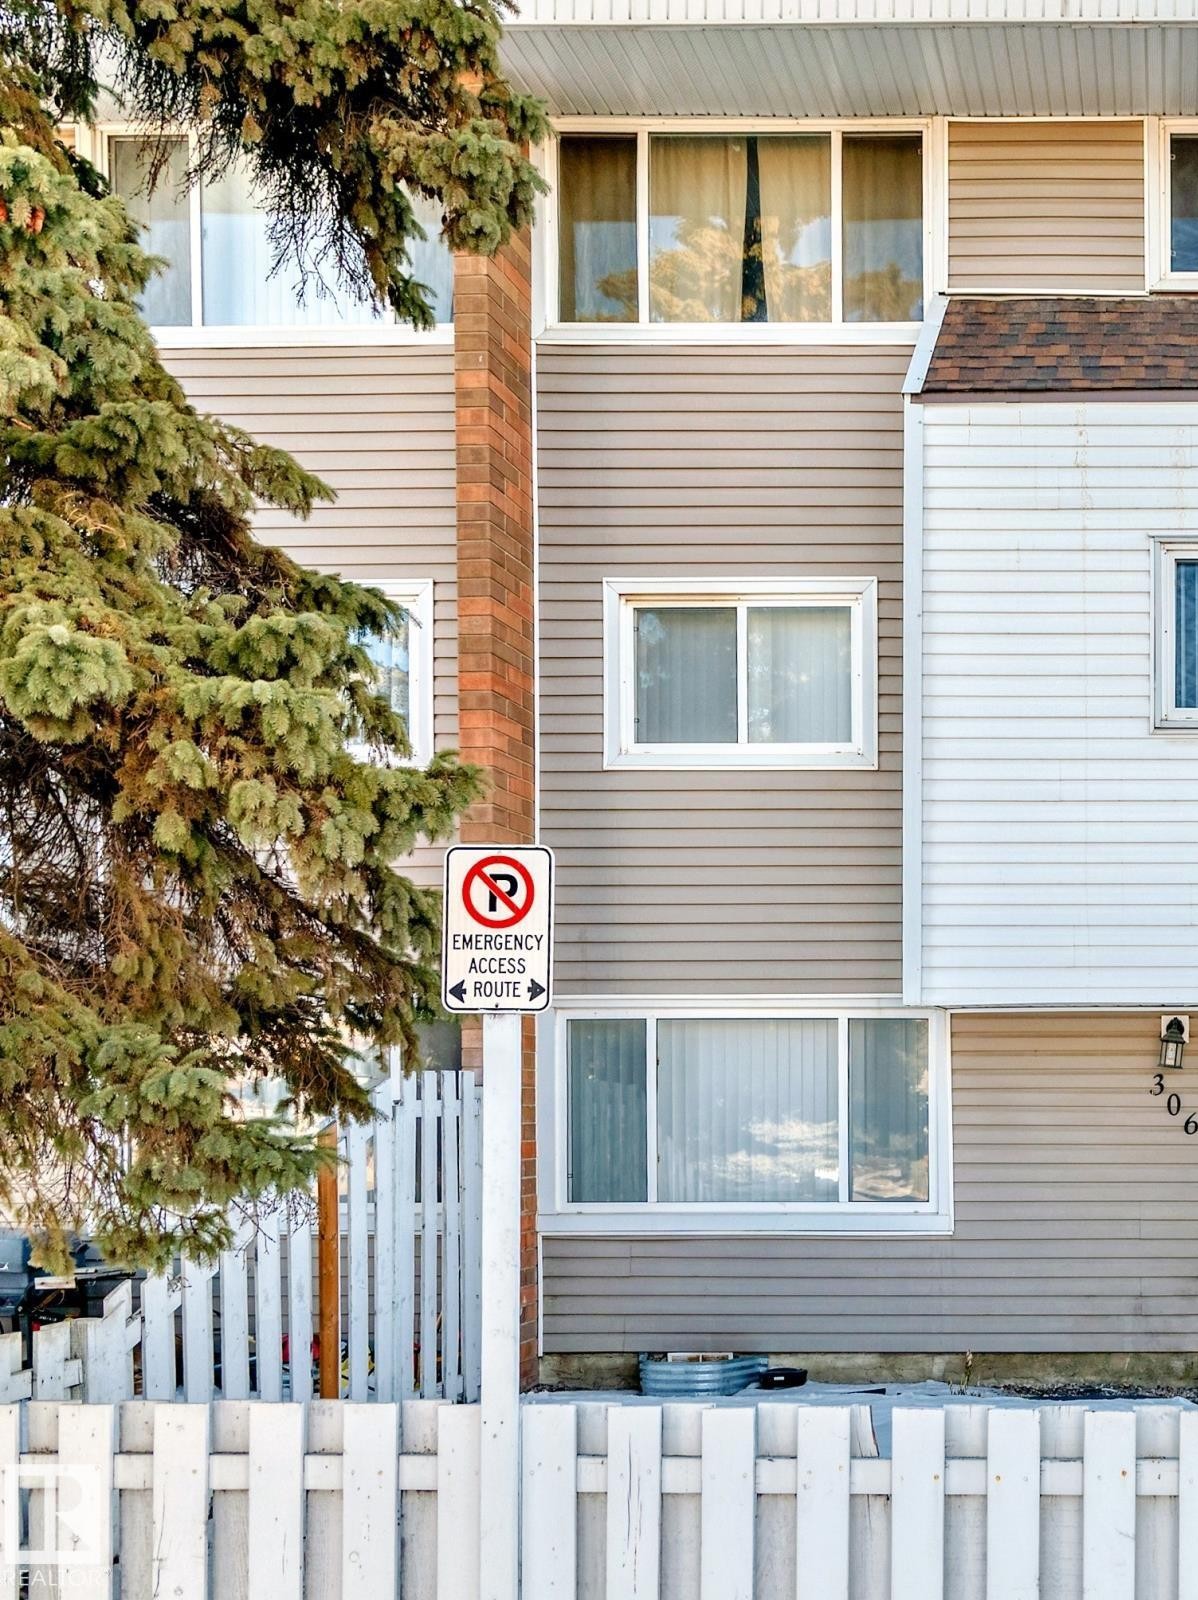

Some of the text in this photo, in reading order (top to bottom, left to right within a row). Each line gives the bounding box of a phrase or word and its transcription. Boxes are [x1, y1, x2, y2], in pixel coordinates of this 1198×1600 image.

[488, 874, 518, 912] P
[453, 934, 543, 950] EMERGENCY
[468, 957, 526, 974] ACCESS
[473, 981, 521, 997] ROUTE
[1149, 1073, 1198, 1135] 306
